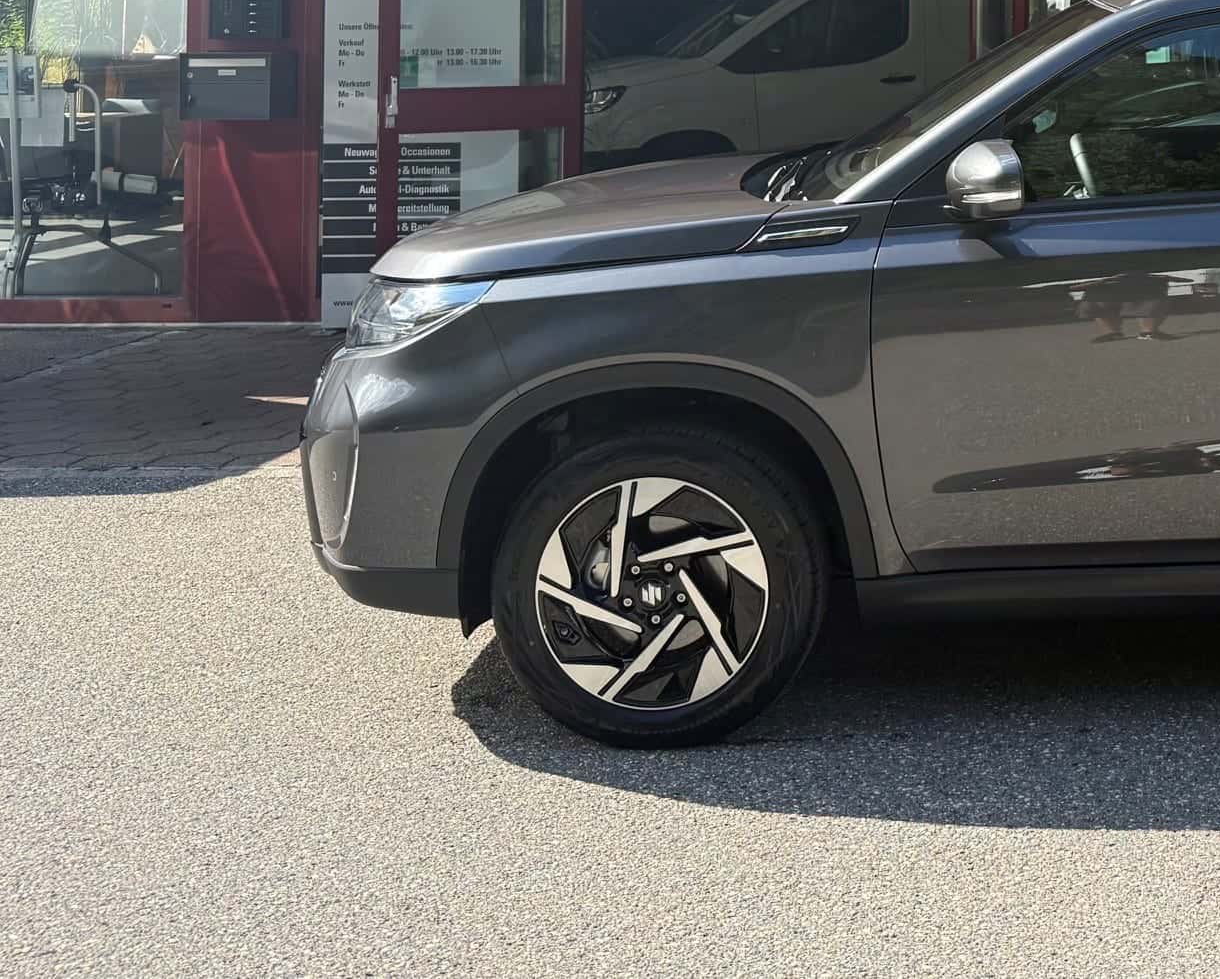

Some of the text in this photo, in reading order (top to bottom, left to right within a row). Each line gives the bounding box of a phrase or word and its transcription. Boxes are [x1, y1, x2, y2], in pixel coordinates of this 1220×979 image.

[338, 39, 365, 47] Verkauf
[401, 146, 450, 157] Occasionen
[411, 165, 450, 175] Unterhalt
